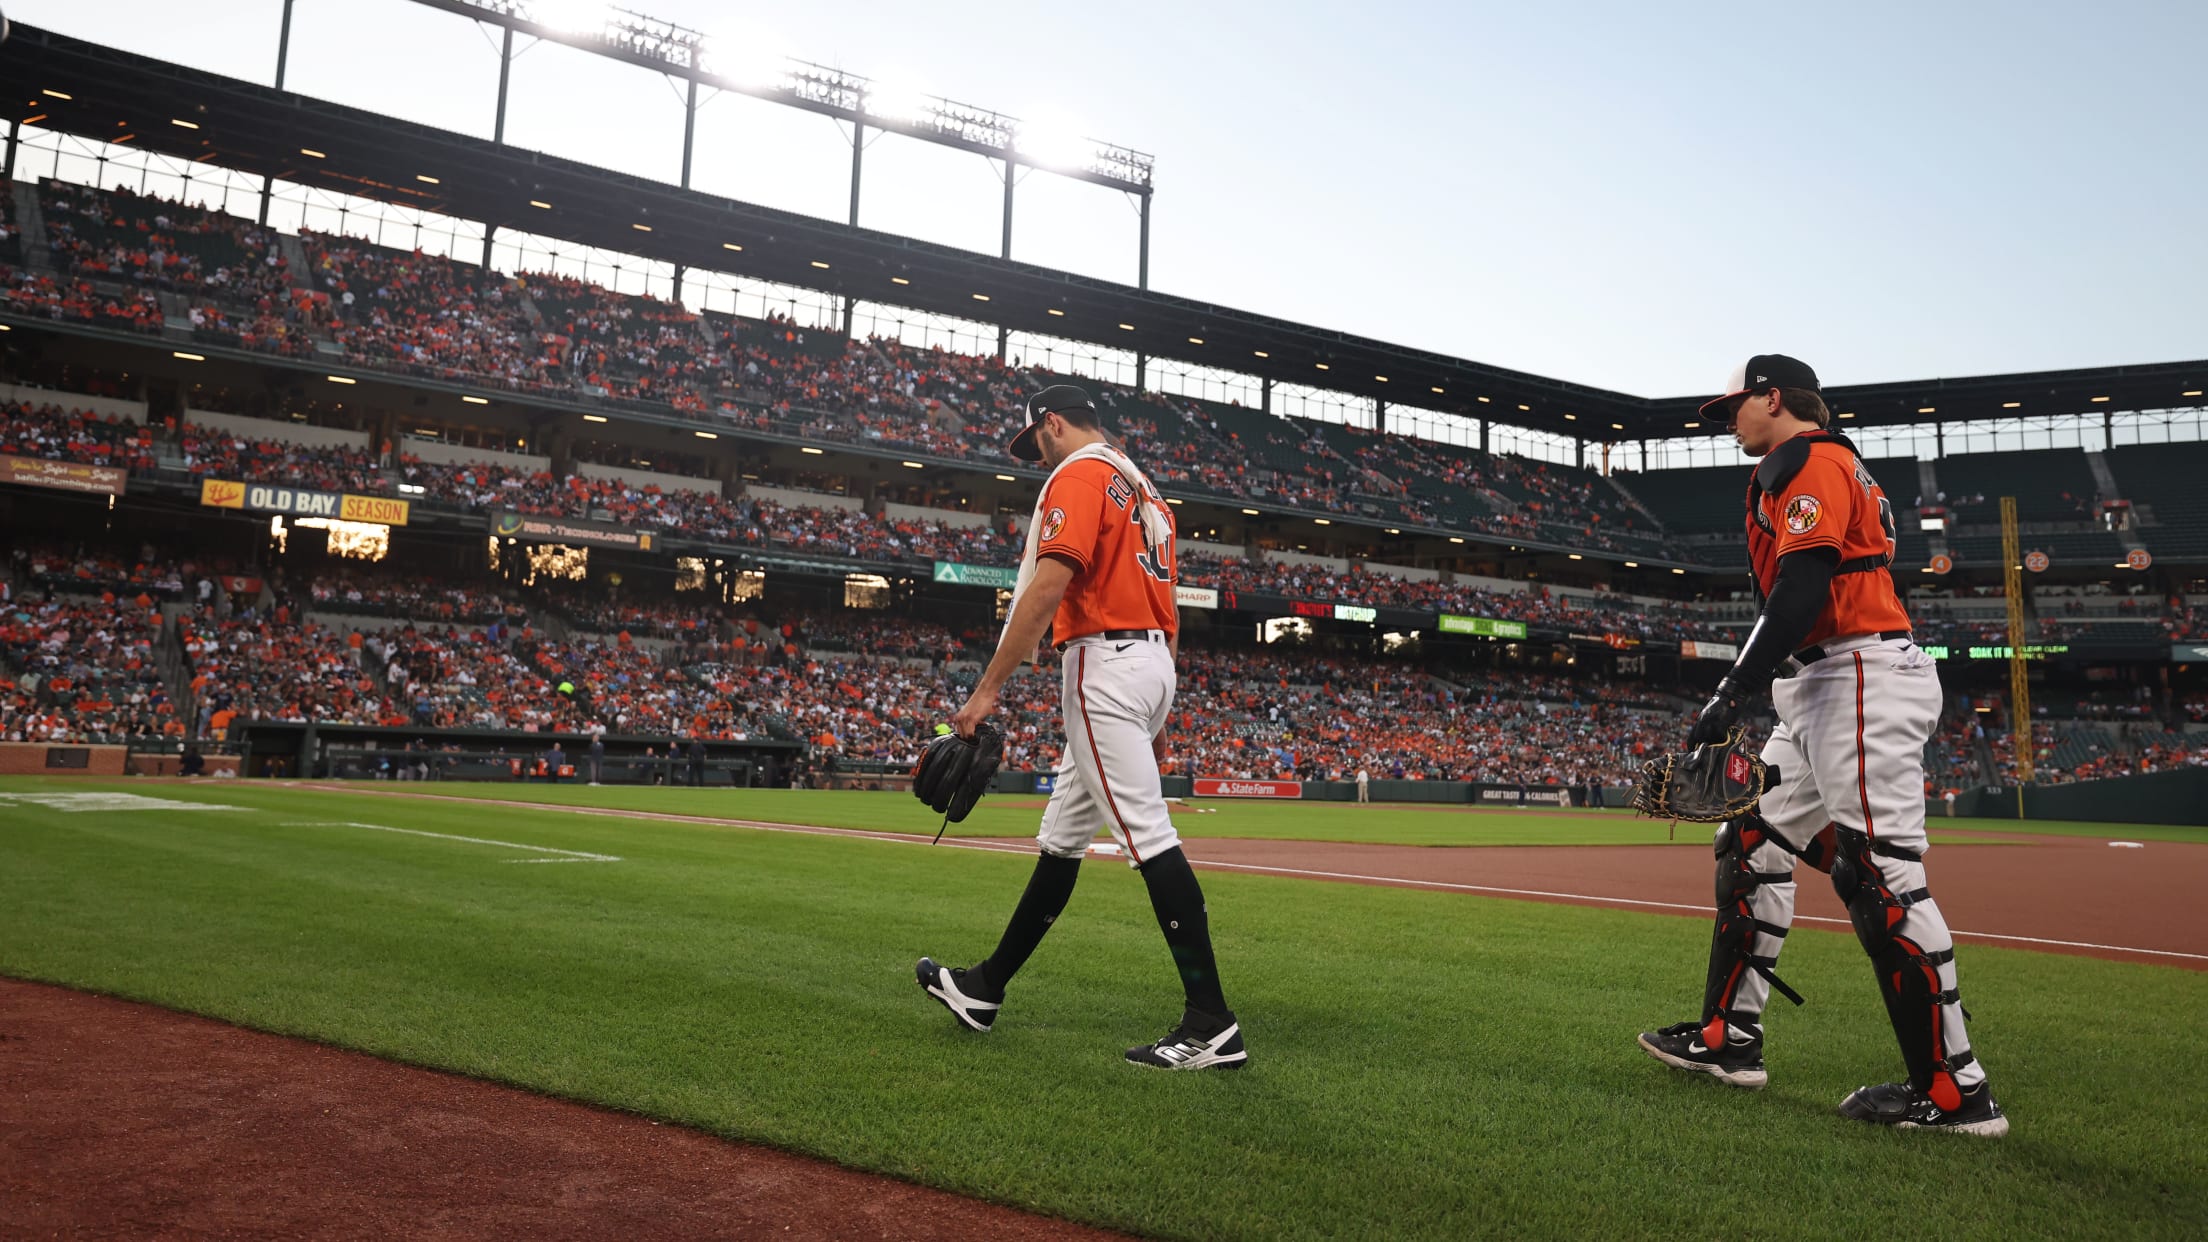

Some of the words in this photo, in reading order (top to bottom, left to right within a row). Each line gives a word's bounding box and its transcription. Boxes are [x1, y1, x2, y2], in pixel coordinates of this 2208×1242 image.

[251, 487, 291, 510] OLD
[346, 498, 403, 521] SEASON
[1936, 558, 1945, 571] 4
[2029, 556, 2046, 568] 22
[2130, 554, 2148, 566] 33
[1177, 592, 1211, 602] SHARP
[1483, 789, 1502, 799] GREAT
